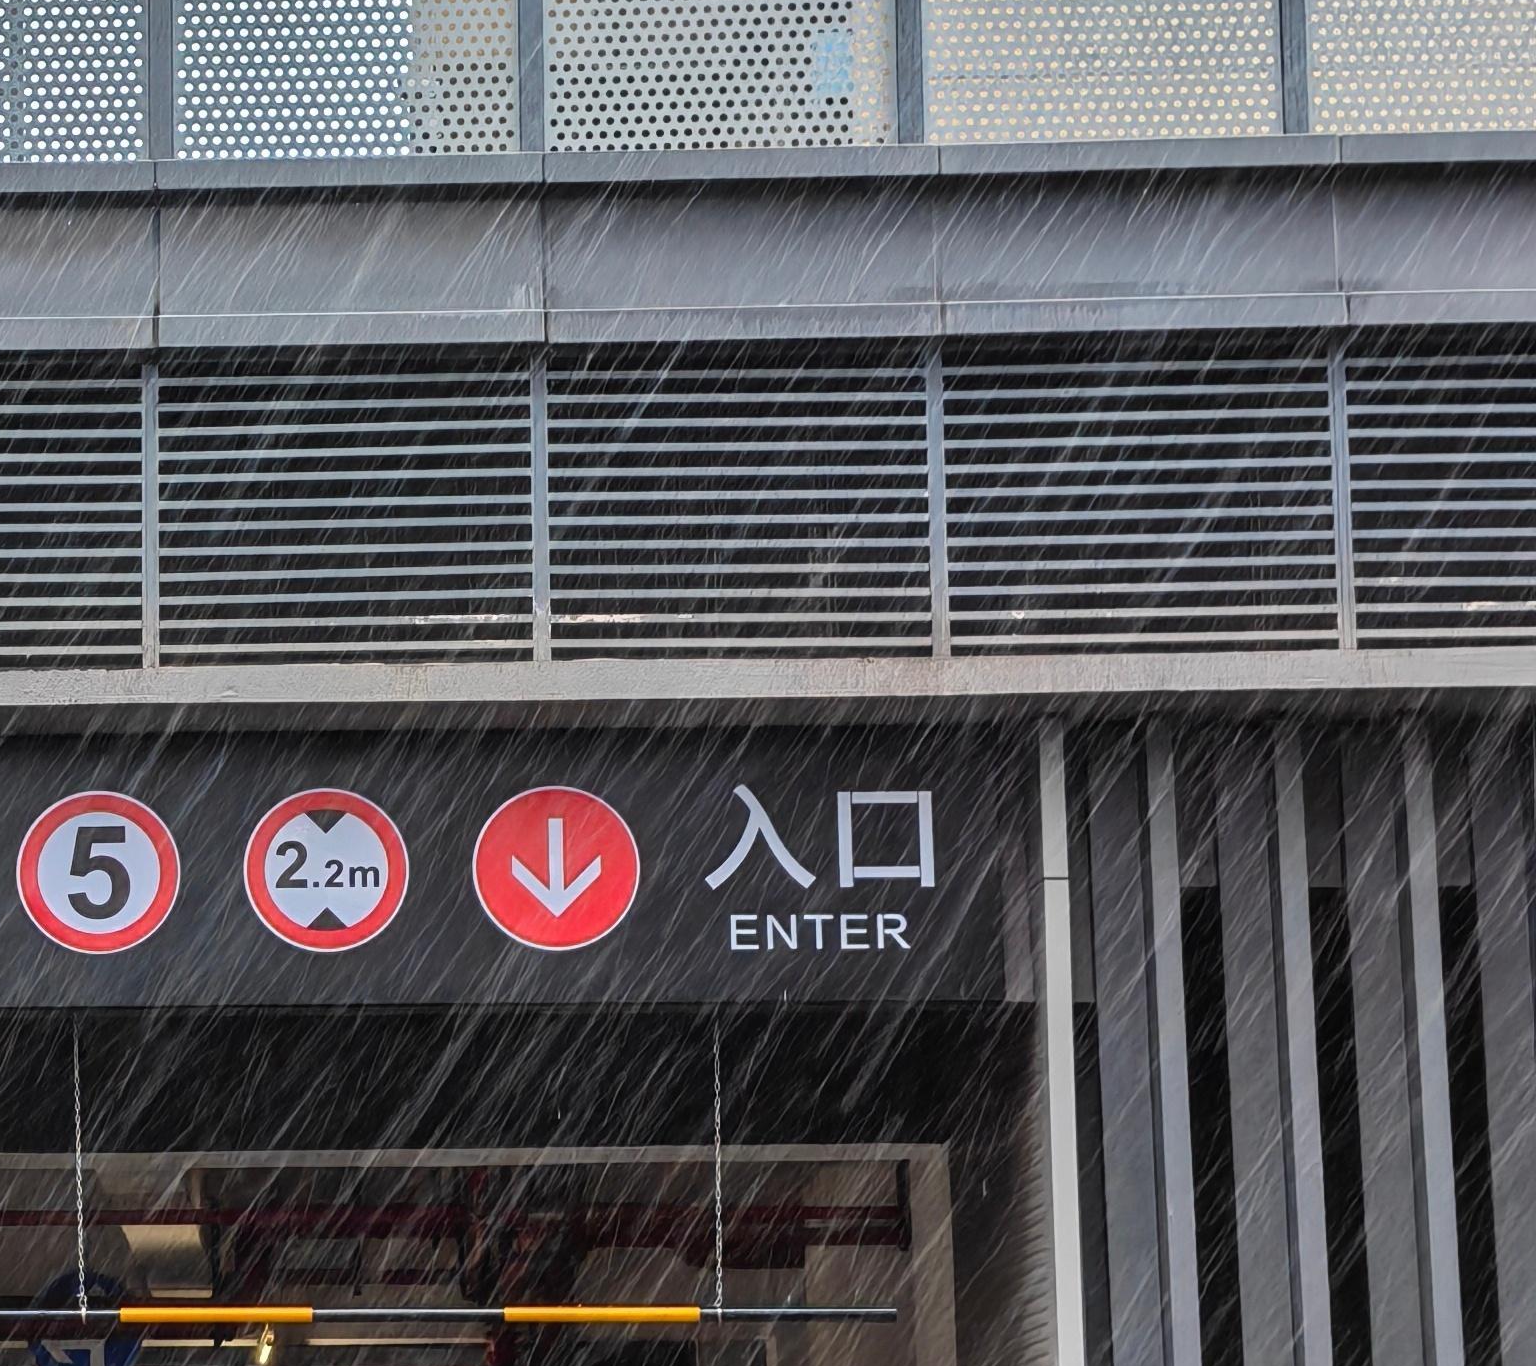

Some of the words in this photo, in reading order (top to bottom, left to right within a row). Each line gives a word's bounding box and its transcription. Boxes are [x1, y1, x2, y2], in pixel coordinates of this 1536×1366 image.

[66, 824, 131, 921] 5
[275, 838, 382, 892] 2.2m
[703, 784, 937, 891] 入口
[730, 912, 912, 952] ENTER
